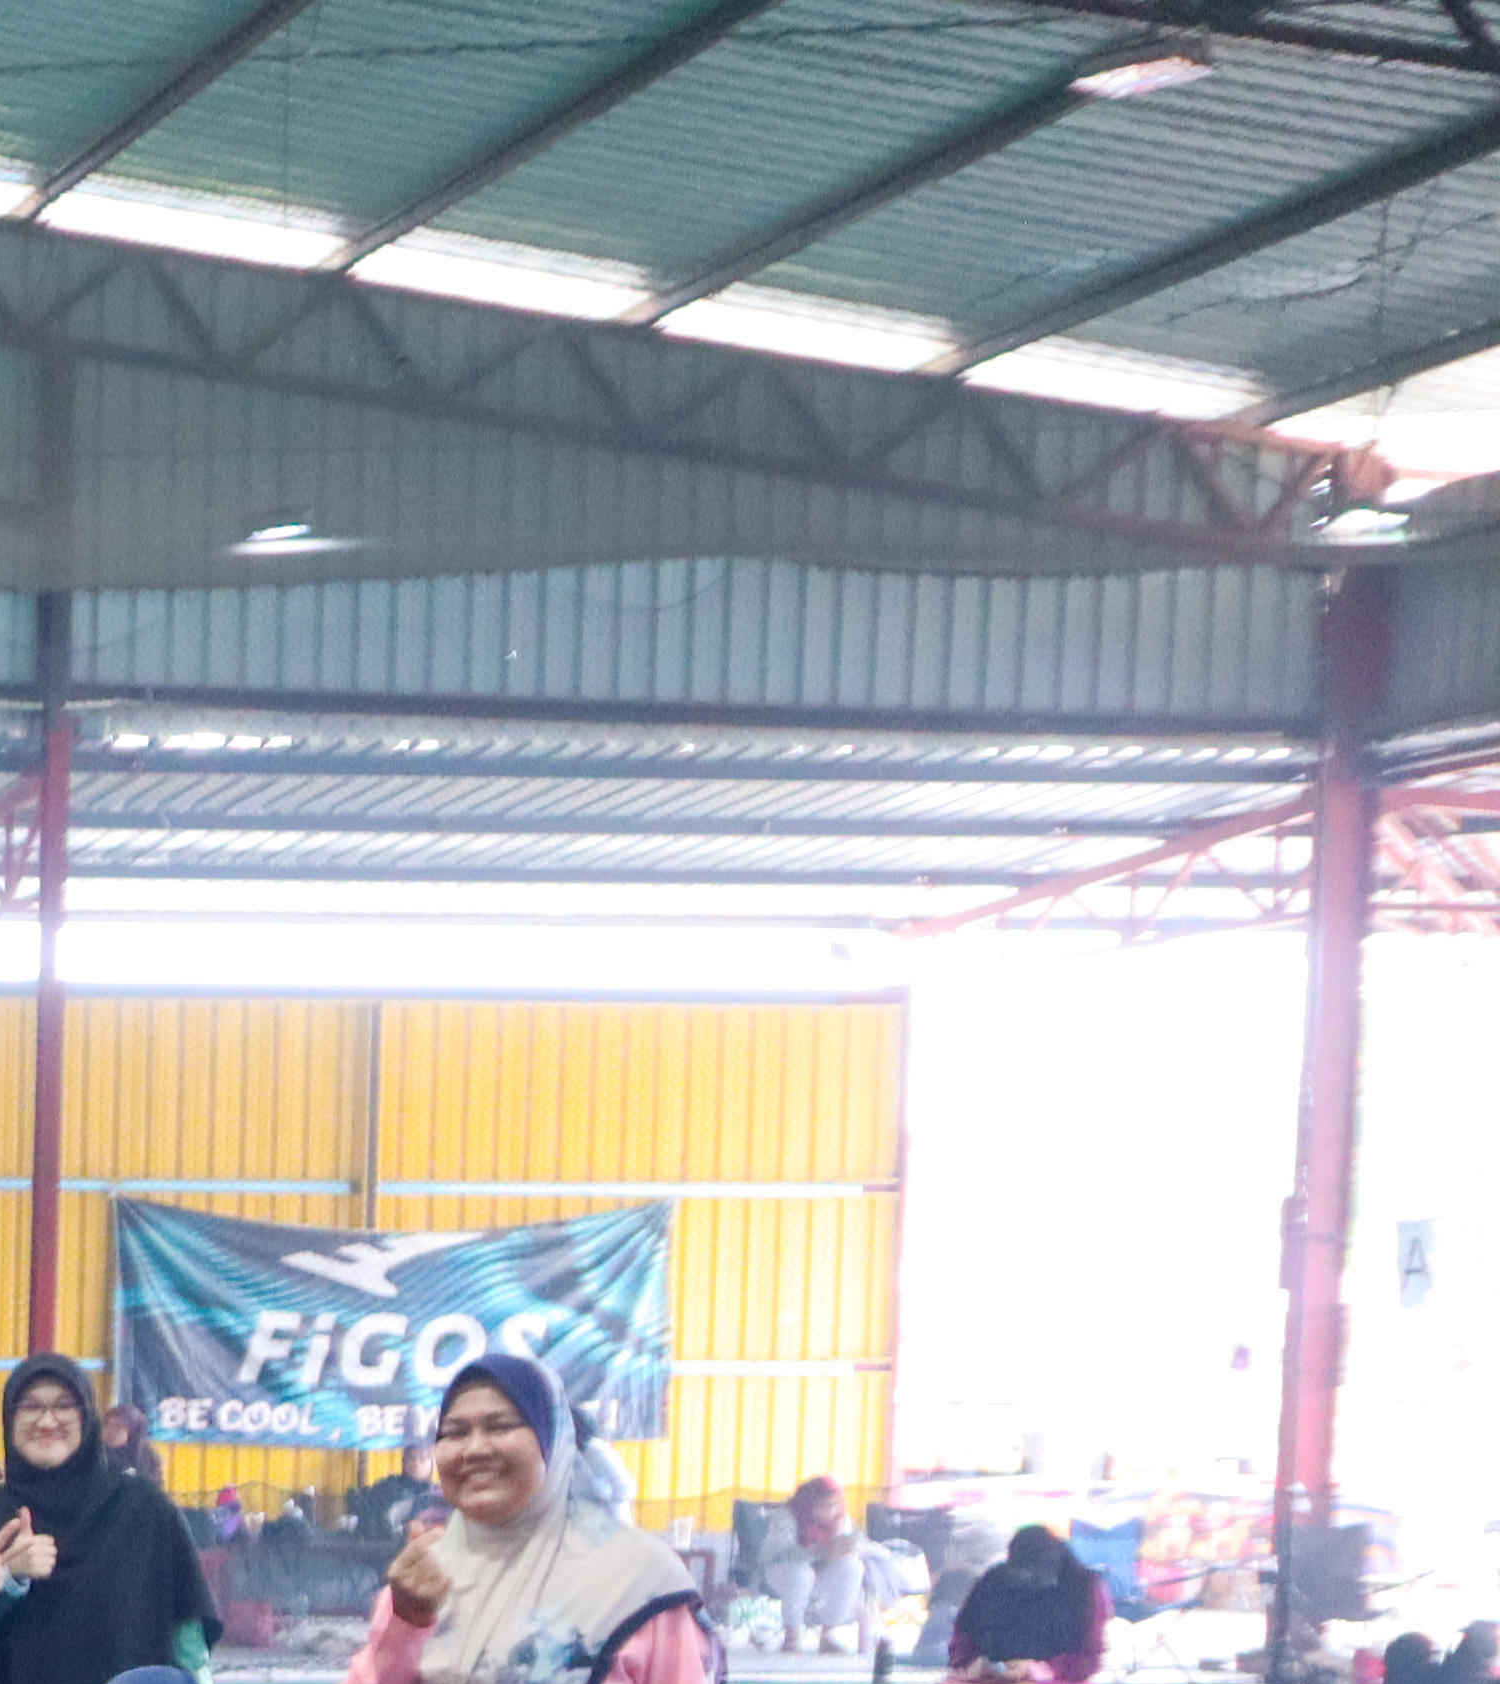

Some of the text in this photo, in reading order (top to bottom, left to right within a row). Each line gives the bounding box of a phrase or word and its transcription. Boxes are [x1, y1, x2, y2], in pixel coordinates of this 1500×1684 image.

[158, 1396, 213, 1430] BE
[216, 1399, 321, 1434] COOL
[355, 1404, 408, 1437] BE
